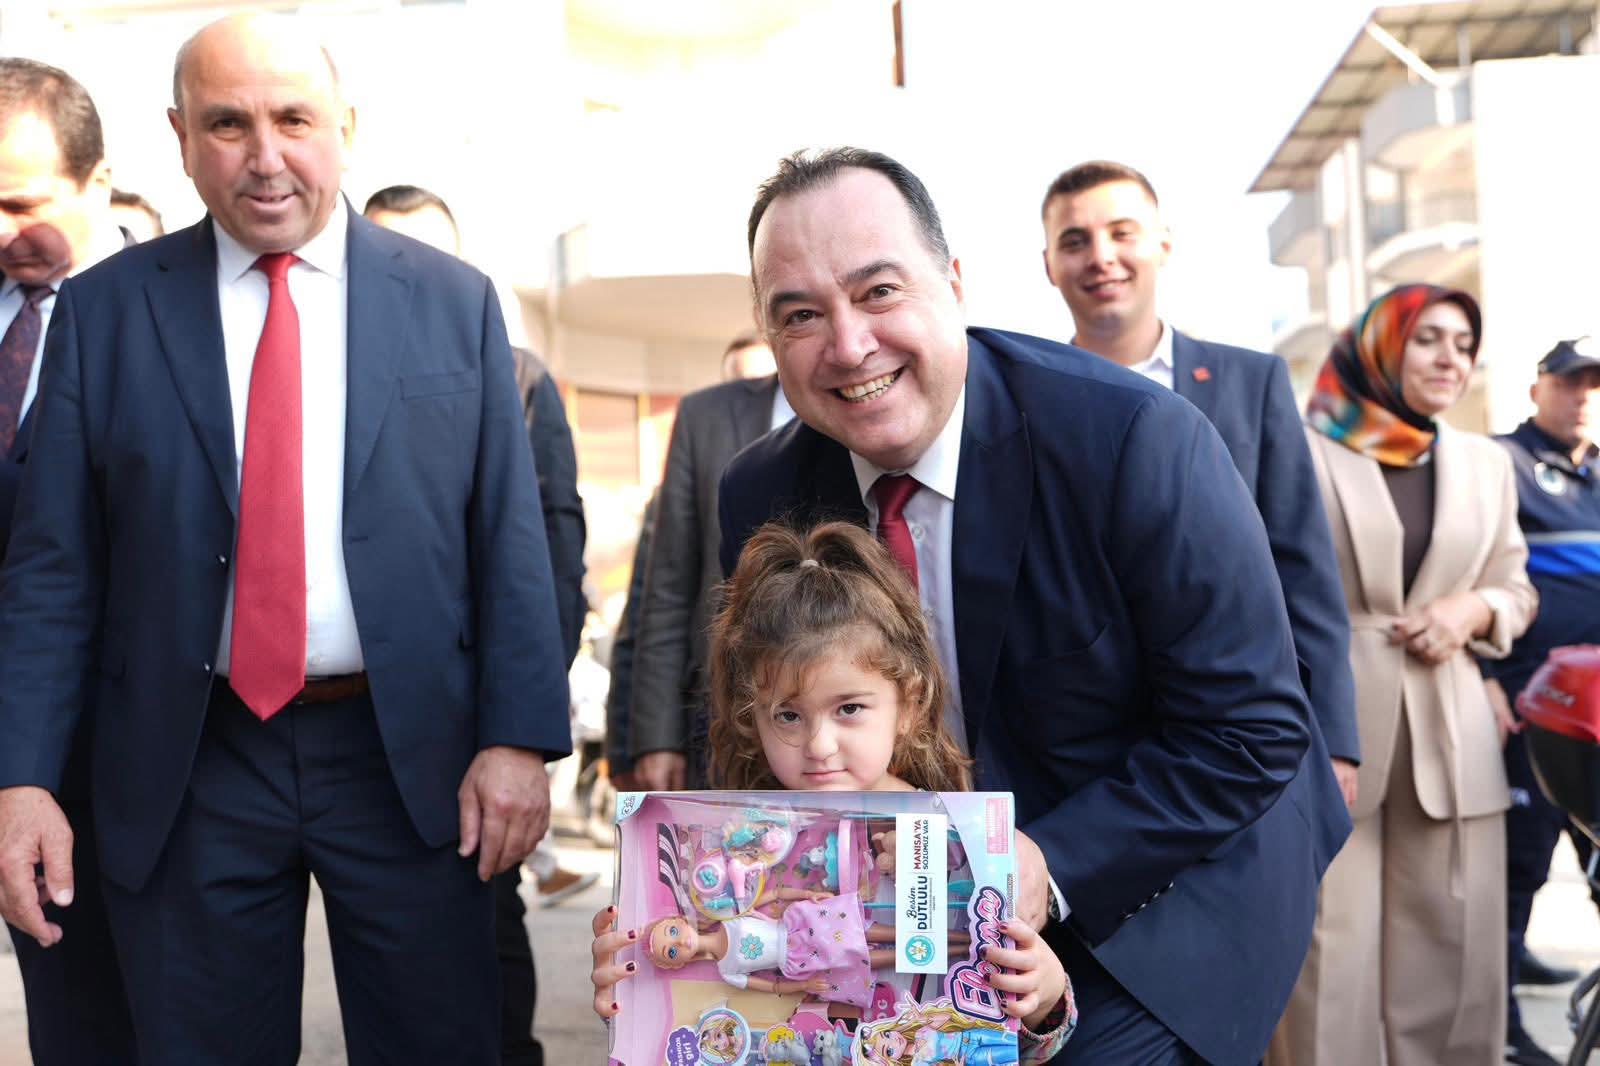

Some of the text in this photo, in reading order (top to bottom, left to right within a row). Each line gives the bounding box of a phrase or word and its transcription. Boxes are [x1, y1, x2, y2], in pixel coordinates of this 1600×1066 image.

[906, 887, 917, 919] Besim
[917, 876, 927, 930] DUTLULU
[683, 1043, 694, 1060] girl
